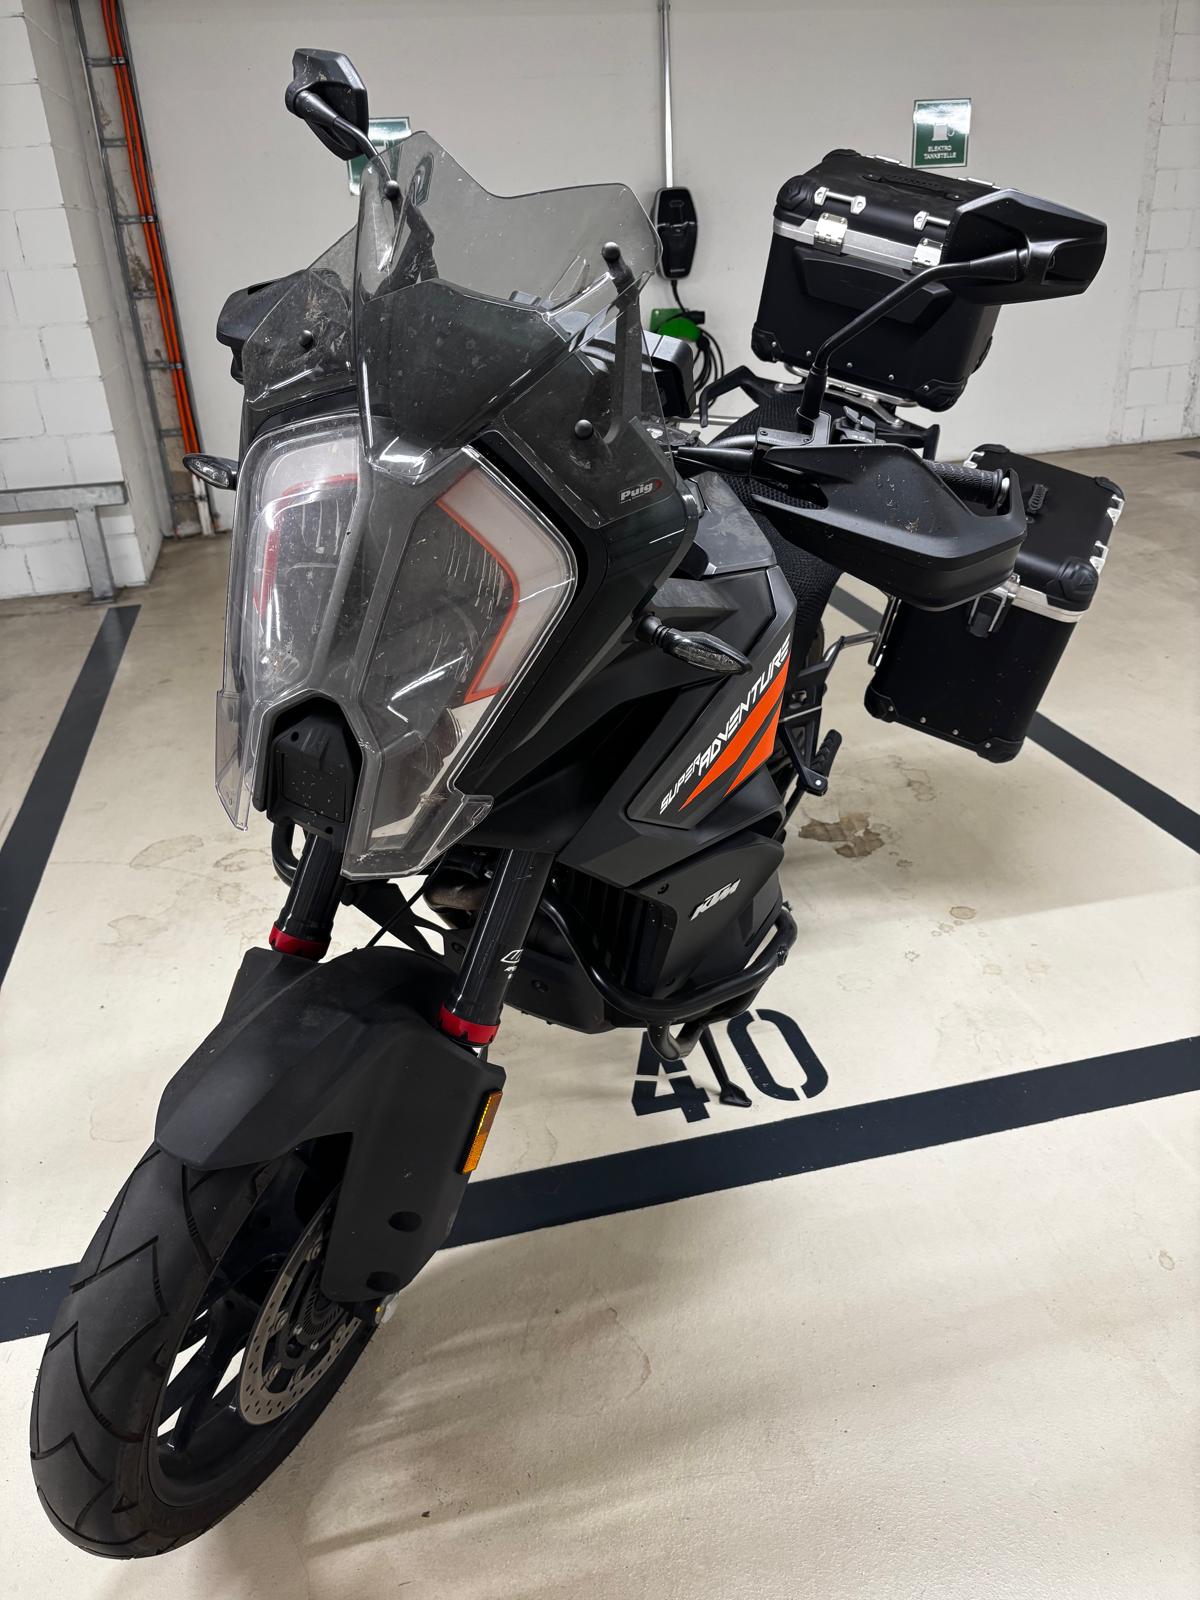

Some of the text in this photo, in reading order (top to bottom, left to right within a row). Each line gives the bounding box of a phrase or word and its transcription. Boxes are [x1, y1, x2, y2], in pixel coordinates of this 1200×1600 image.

[923, 152, 957, 160] TANKSTELLE
[620, 482, 653, 501] Puig
[659, 632, 791, 815] SUPER ADVENTURE
[690, 879, 741, 921] KTM
[631, 1008, 829, 1123] 40
